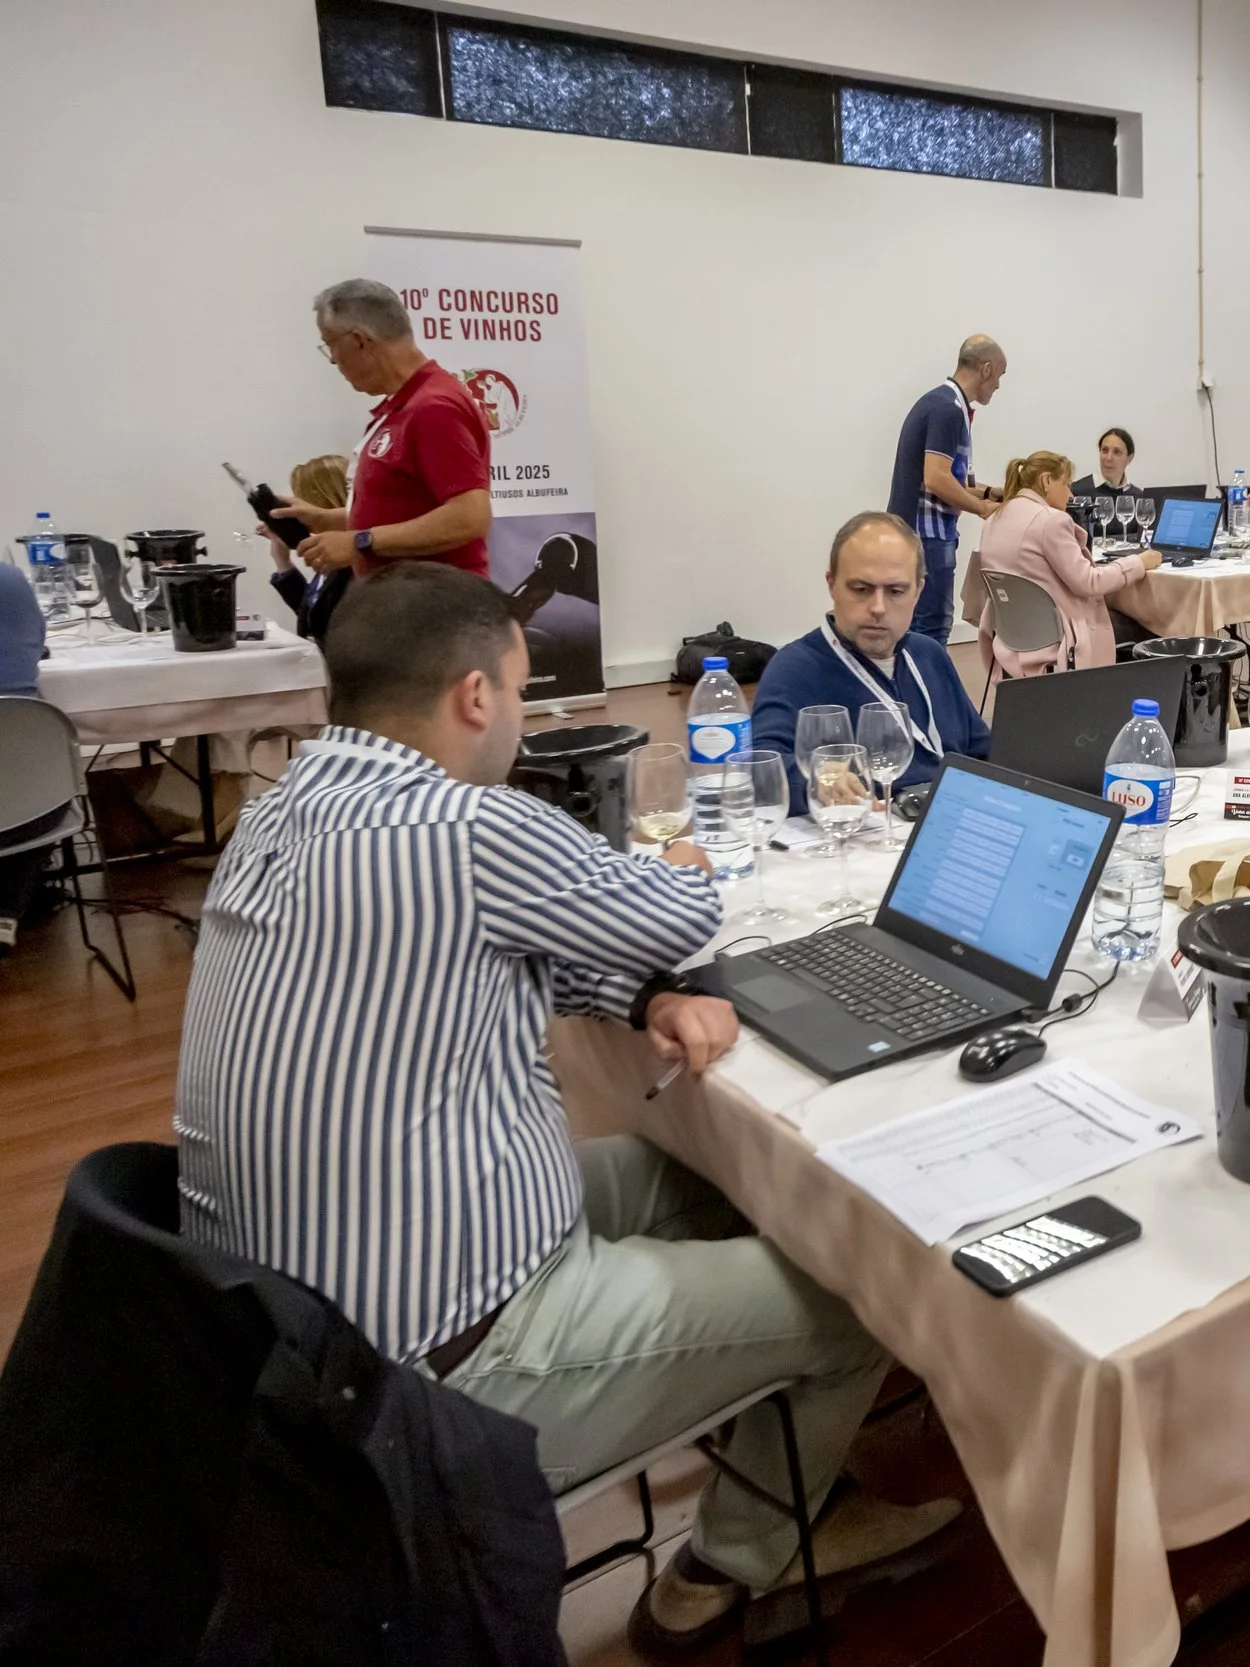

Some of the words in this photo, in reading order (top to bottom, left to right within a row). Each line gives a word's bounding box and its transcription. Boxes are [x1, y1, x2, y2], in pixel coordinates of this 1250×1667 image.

[438, 288, 559, 315] CONCURSO
[423, 317, 452, 340] DE
[460, 318, 542, 342] VINHOS
[490, 465, 511, 480] RIL
[515, 465, 550, 480] 2025
[491, 489, 523, 499] LTIUSOS
[526, 487, 568, 497] ALBUFEIRA
[1112, 791, 1146, 807] LUSO
